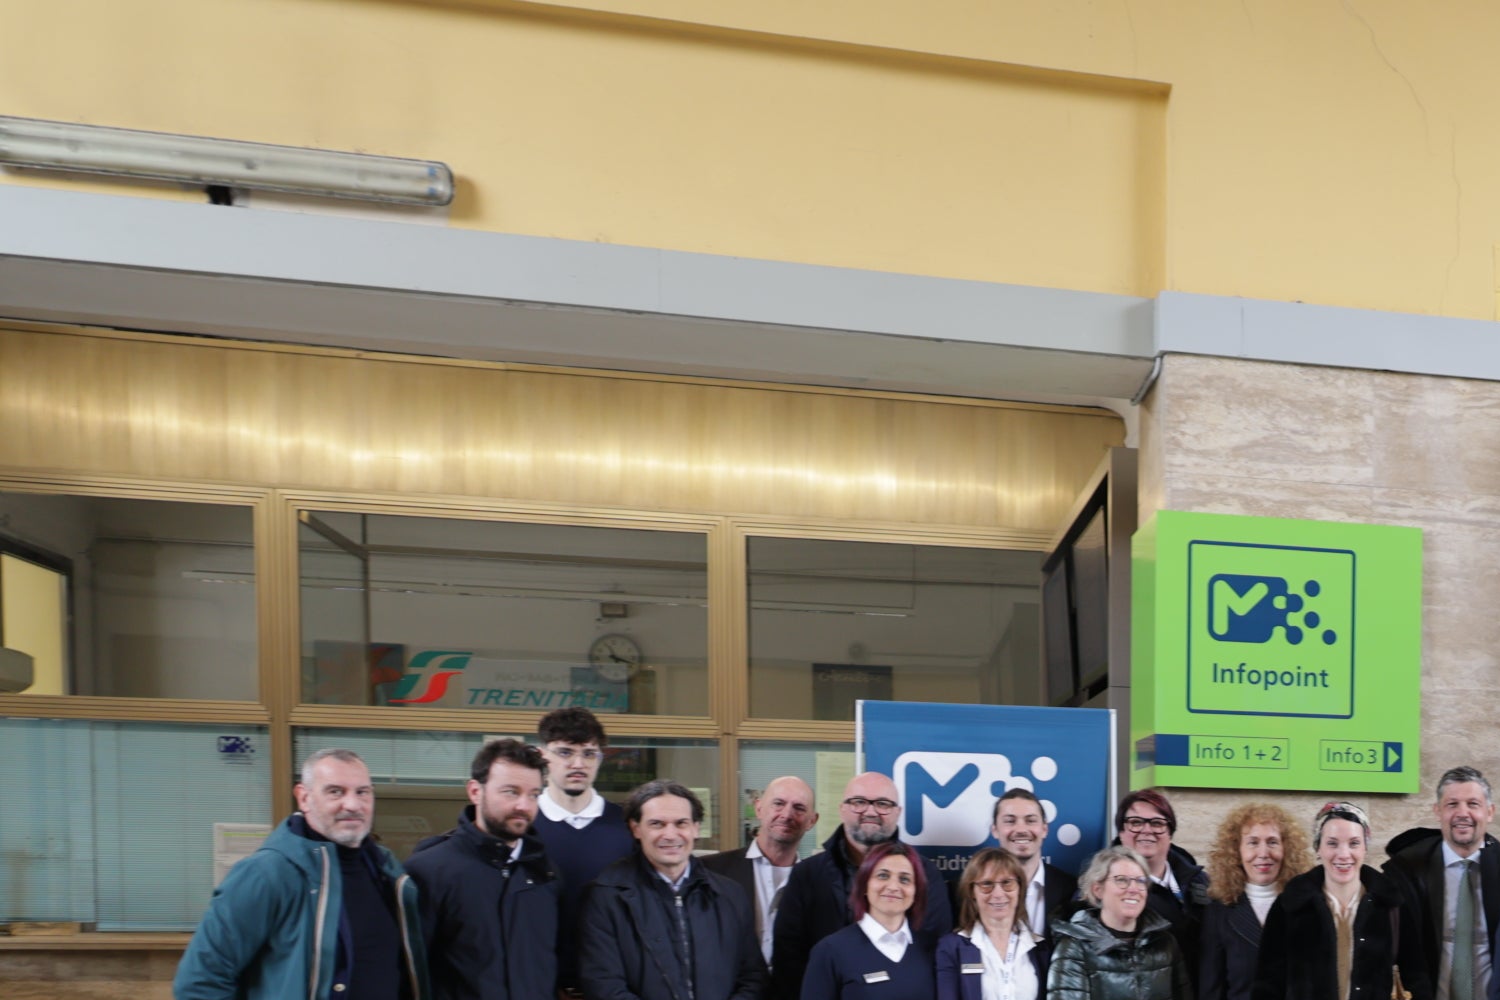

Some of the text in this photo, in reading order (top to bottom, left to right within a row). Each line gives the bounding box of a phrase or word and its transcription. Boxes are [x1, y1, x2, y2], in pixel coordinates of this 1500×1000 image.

[1212, 662, 1329, 691] Infopoint
[467, 687, 628, 710] TRENITALIA
[1195, 742, 1235, 761] Info
